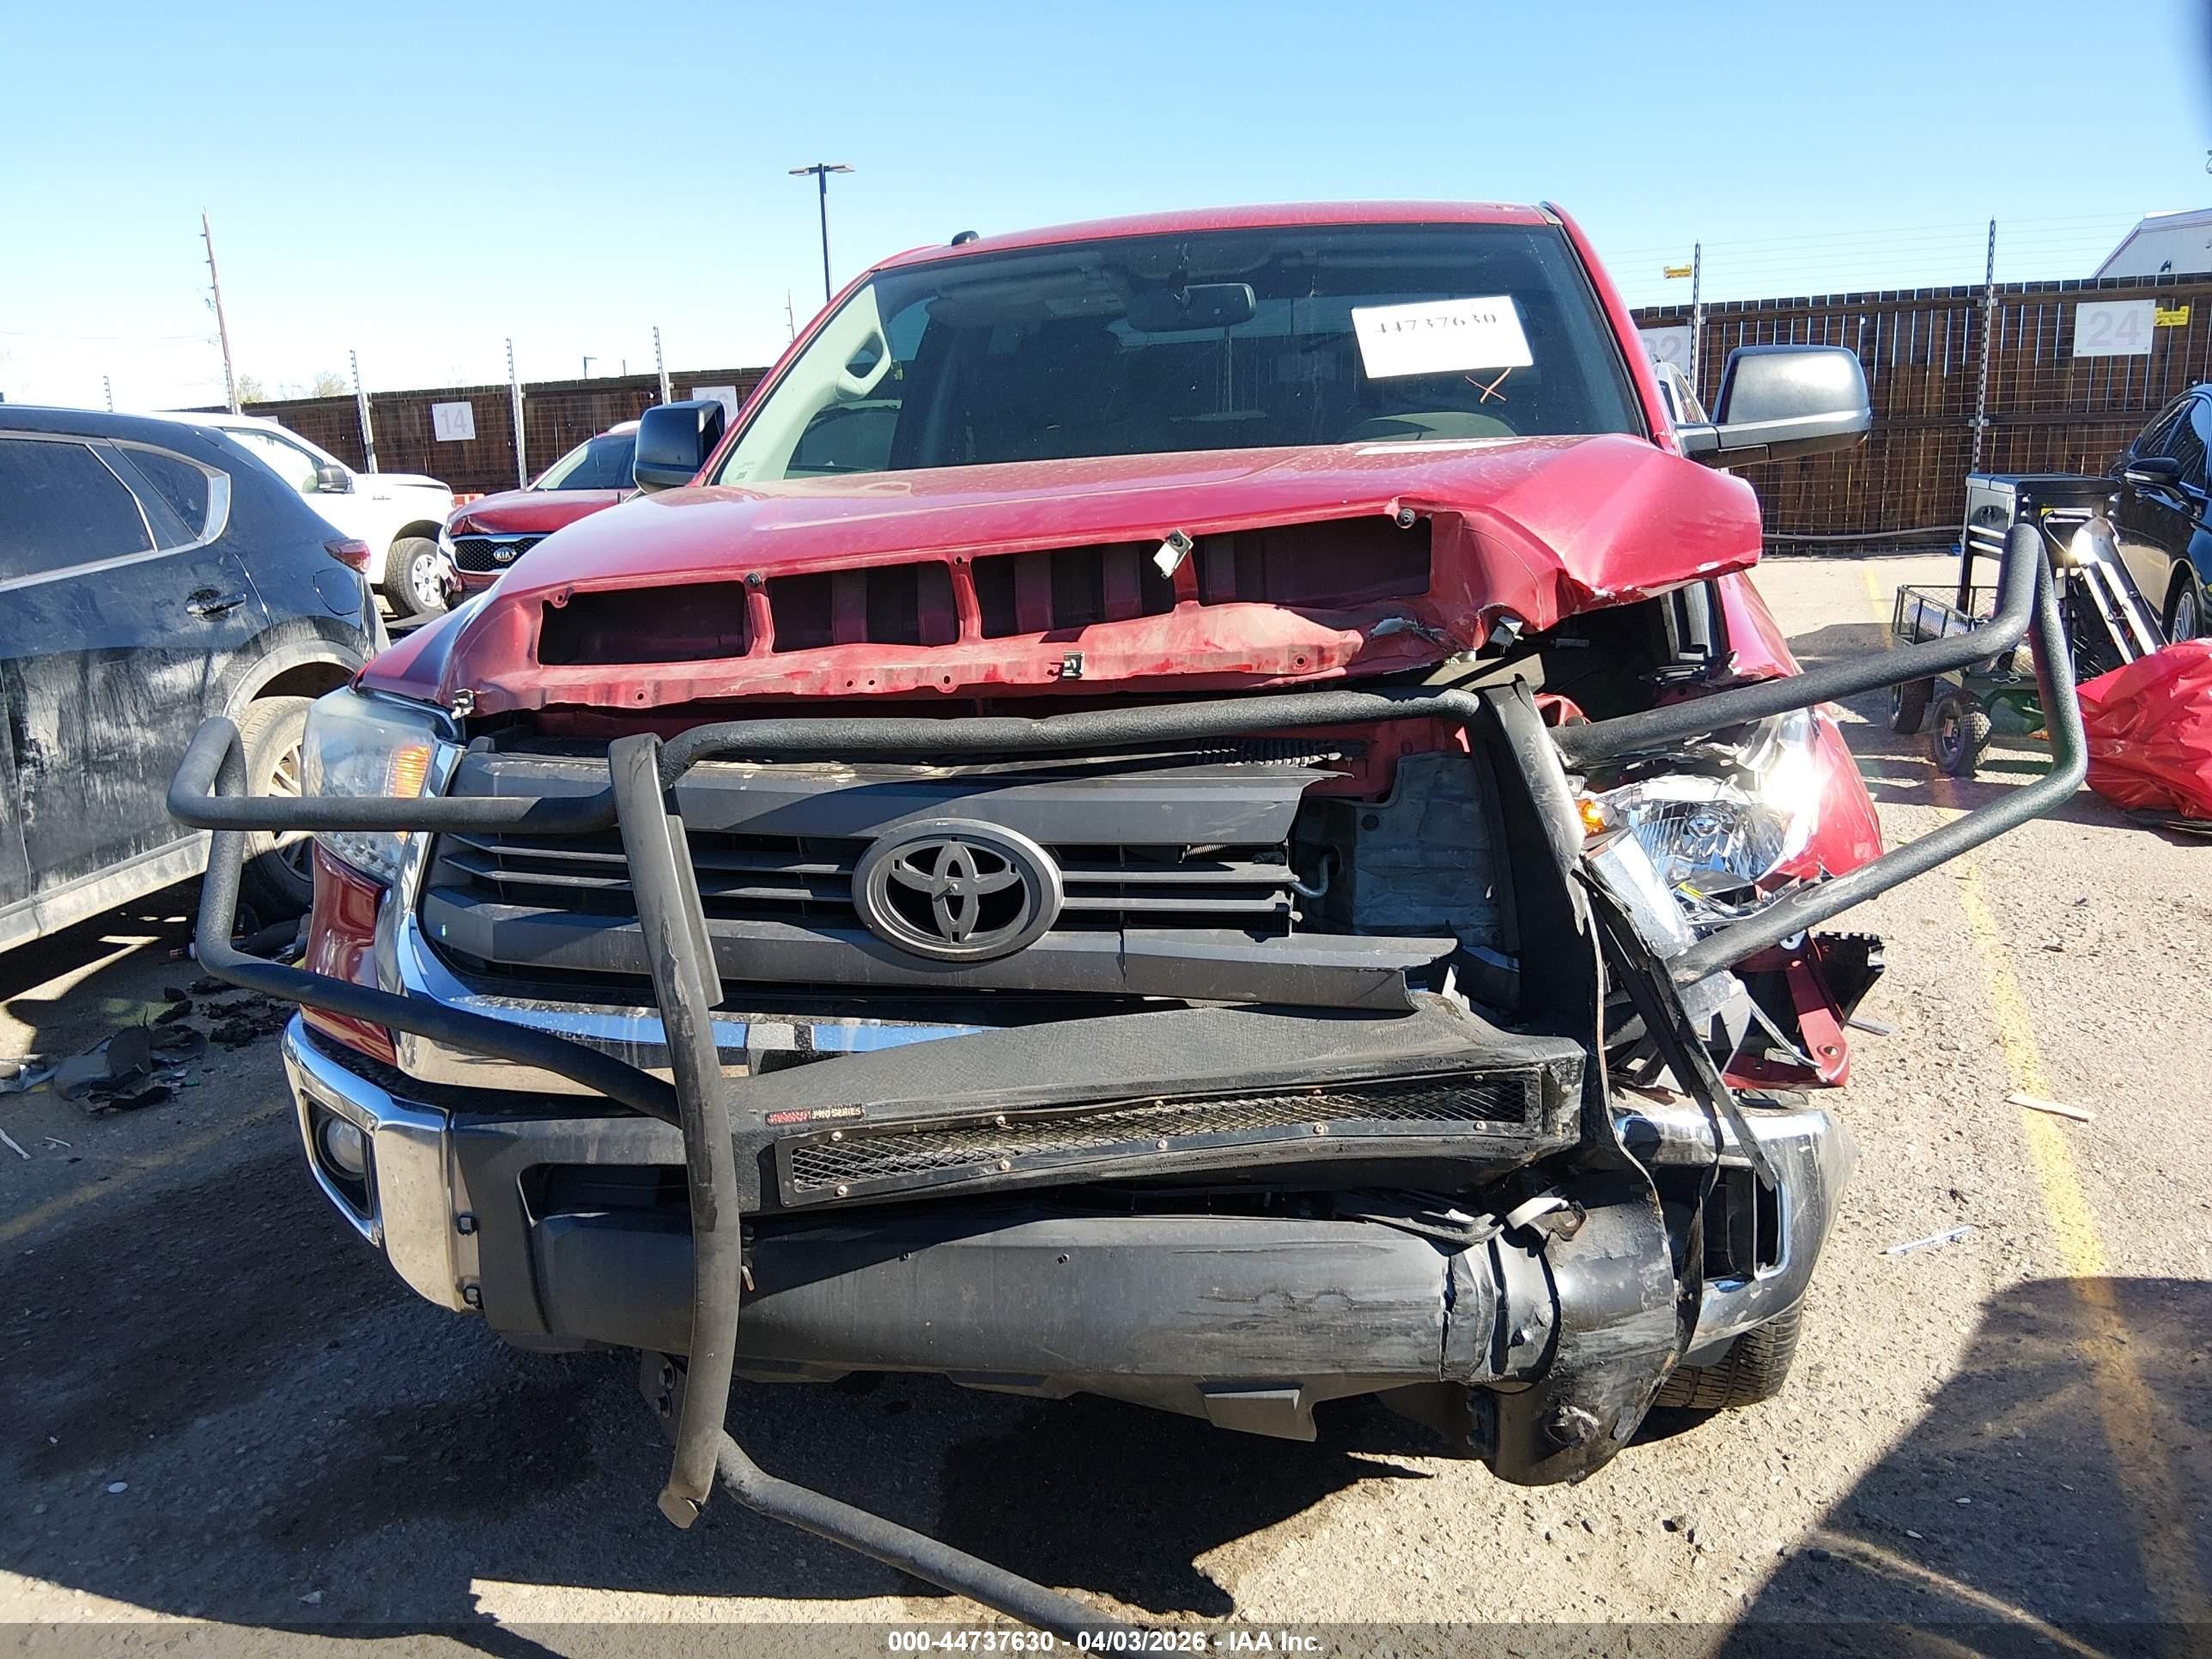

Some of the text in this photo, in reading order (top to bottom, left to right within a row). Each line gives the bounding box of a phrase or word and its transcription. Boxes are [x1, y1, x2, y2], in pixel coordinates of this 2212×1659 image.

[2087, 309, 2142, 347] 24
[441, 408, 468, 434] 14
[811, 1109, 831, 1120] PRO
[831, 1107, 862, 1118] SERIES
